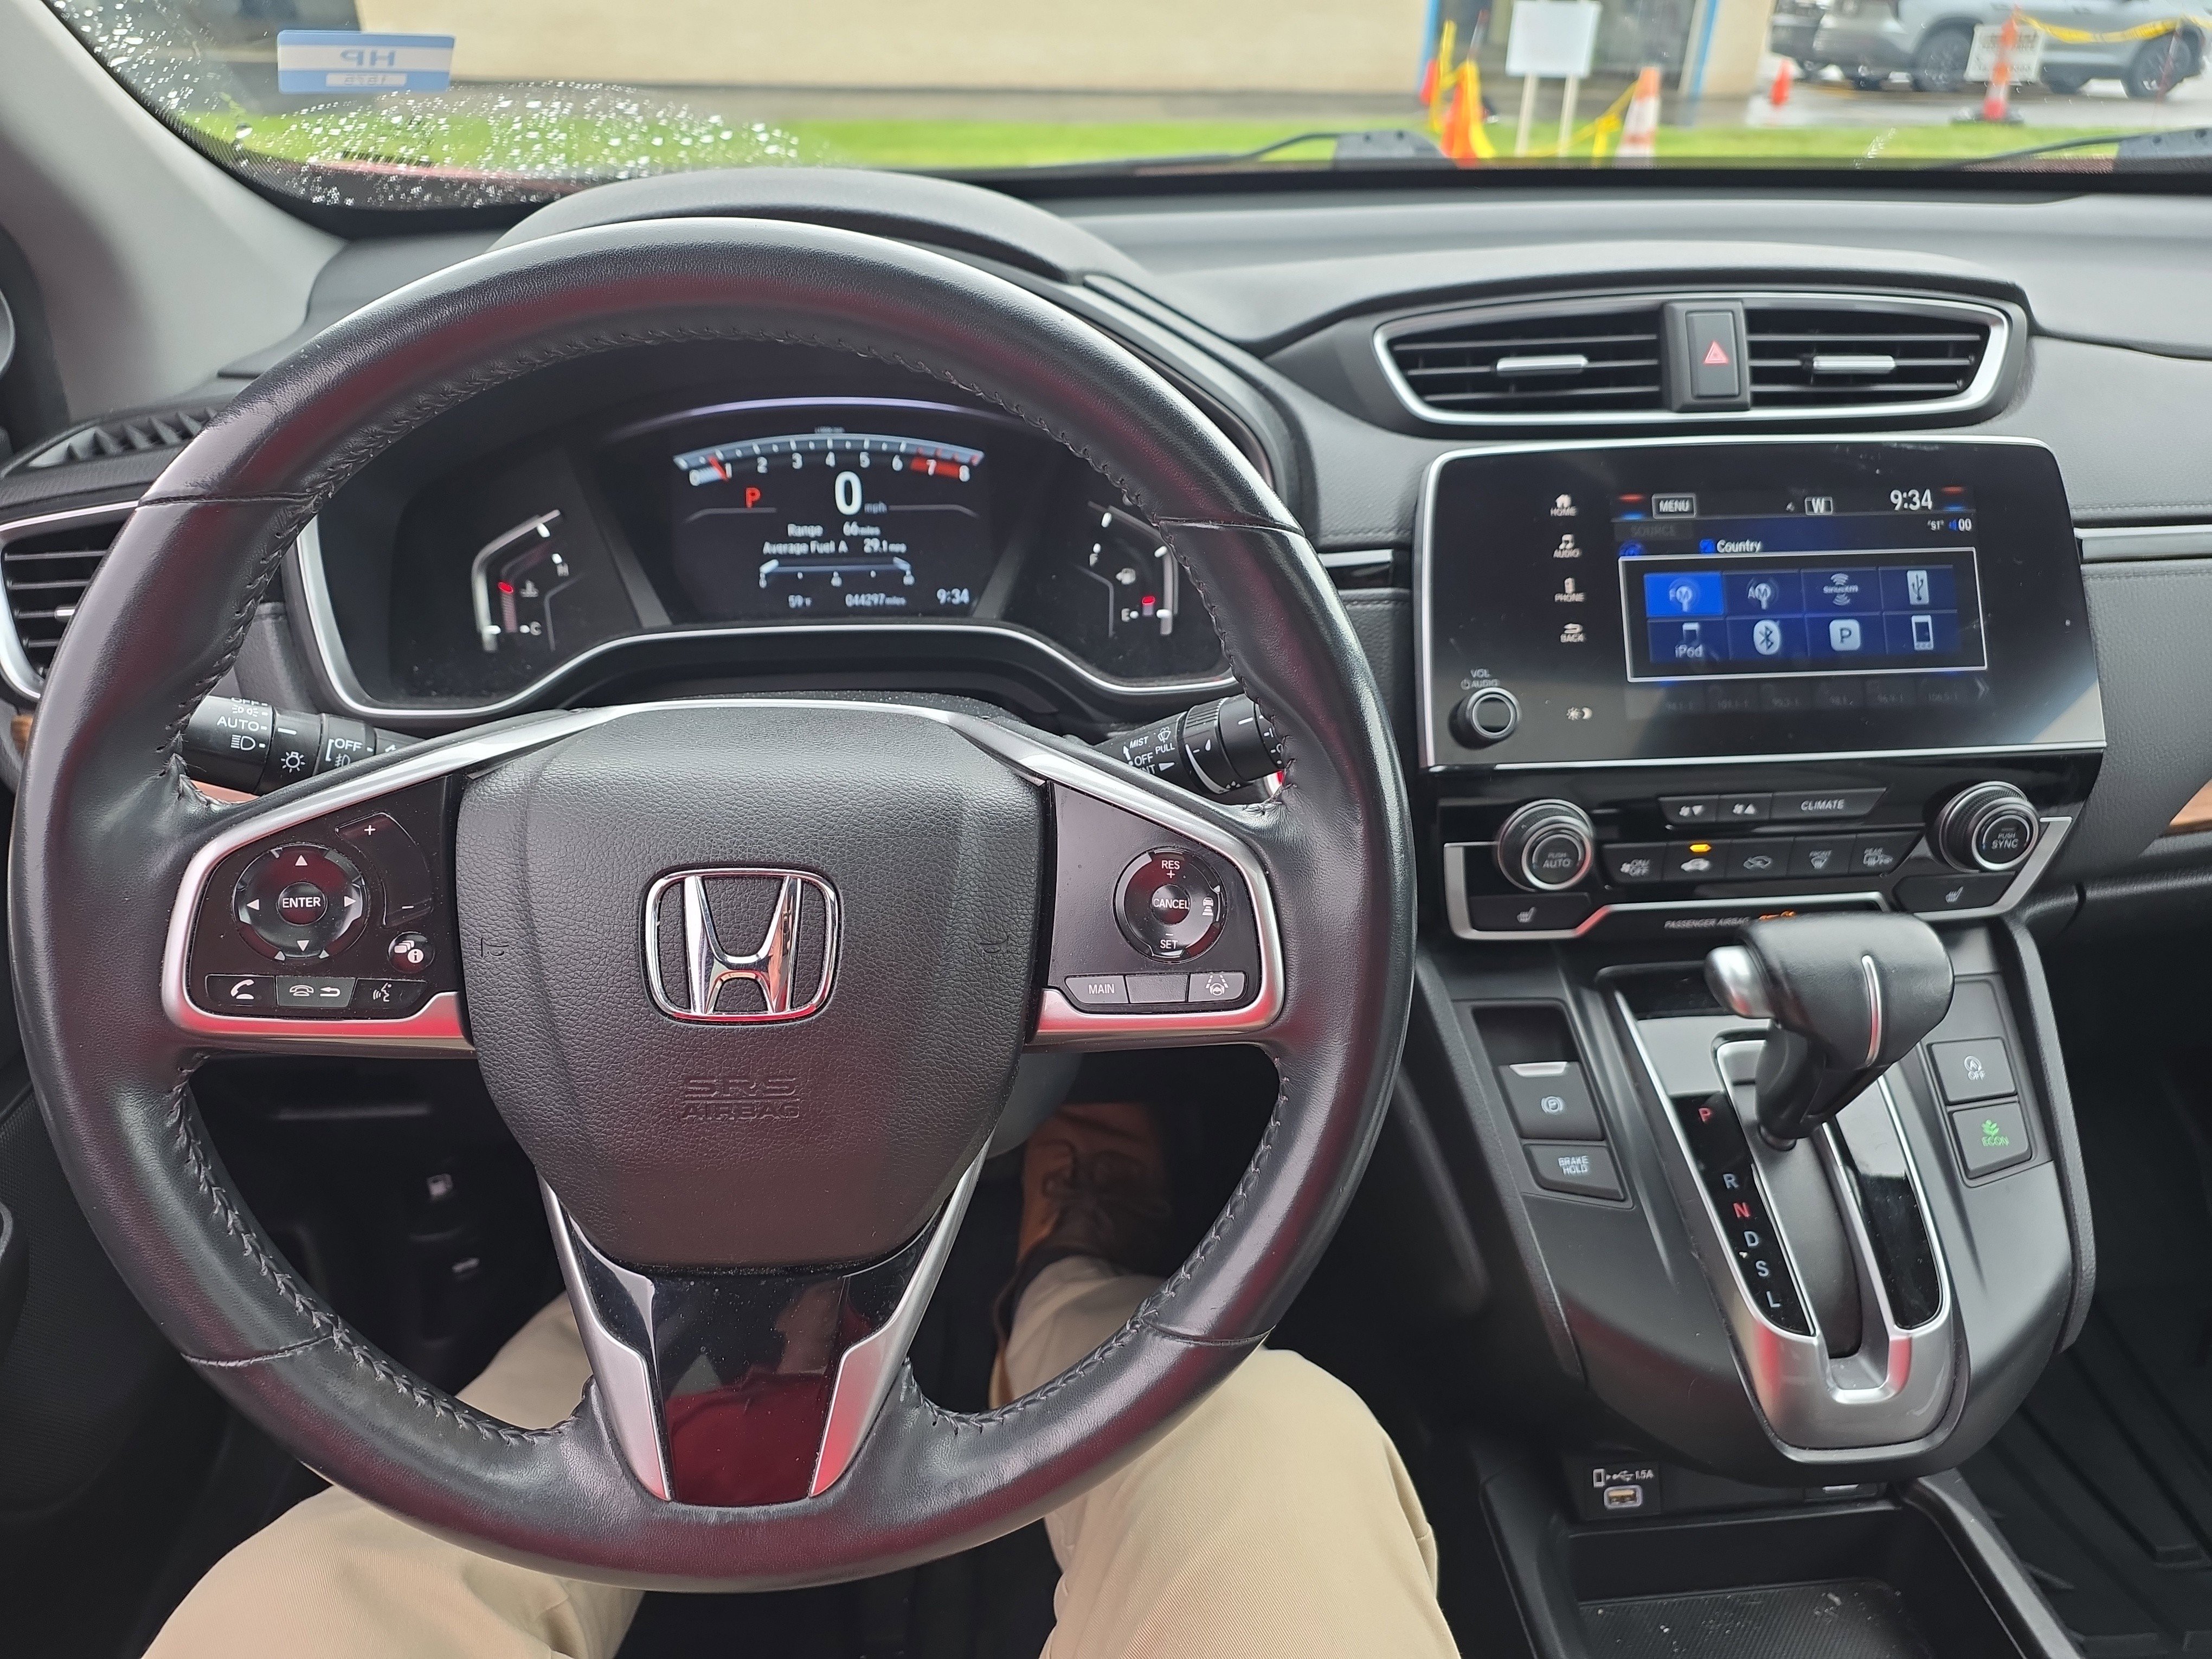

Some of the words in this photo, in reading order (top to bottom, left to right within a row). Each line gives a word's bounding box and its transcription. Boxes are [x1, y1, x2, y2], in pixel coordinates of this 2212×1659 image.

[757, 456, 768, 473] 2
[792, 453, 802, 469] 3
[826, 452, 835, 467] 4
[860, 452, 870, 468] 5
[892, 454, 903, 471] 6
[926, 459, 936, 475] 7
[959, 465, 970, 482] 8
[746, 487, 760, 507] P
[835, 471, 862, 515] 0
[1890, 488, 1933, 511] 9:34
[1550, 506, 1577, 516] HOME
[1659, 499, 1690, 512] MENU
[1811, 497, 1824, 513] W
[788, 524, 823, 537] Range
[763, 541, 809, 556] Average
[810, 541, 835, 554] Fuel
[1716, 539, 1762, 553] Country
[1553, 549, 1581, 558] AUDIO
[936, 588, 969, 605] 9:34
[1554, 593, 1586, 602] PHONE
[529, 621, 542, 636] C
[1675, 644, 1703, 658] iPod
[1470, 668, 1490, 678] VOL
[1471, 679, 1500, 688] AUDIO
[217, 716, 260, 731] AUTO
[334, 738, 363, 751] OFF
[1130, 736, 1149, 749] MIST
[1155, 743, 1175, 754] PULL
[1134, 753, 1154, 766] OFF
[1801, 799, 1844, 811] CLIMATE
[1991, 839, 2018, 849] SYNC
[1161, 860, 1180, 870] RES
[1542, 858, 1571, 867] AUTO
[282, 896, 321, 909] ENTER
[1153, 897, 1190, 910] CANCEL
[1664, 918, 1716, 928] PASSENGER
[1160, 939, 1178, 949] SET
[1088, 983, 1115, 994] MAIN
[1968, 1070, 1985, 1081] OFF
[684, 1078, 797, 1098] SRS
[682, 1104, 801, 1121] AIRBAG
[1699, 1107, 1712, 1122] P
[1981, 1136, 2009, 1147] ECON
[1558, 1155, 1590, 1166] BRAKE
[1562, 1164, 1589, 1175] HOLD
[1723, 1173, 1739, 1189] R
[1733, 1202, 1751, 1218] N
[1744, 1231, 1759, 1247] D
[1756, 1261, 1769, 1277] S
[1766, 1291, 1781, 1308] L
